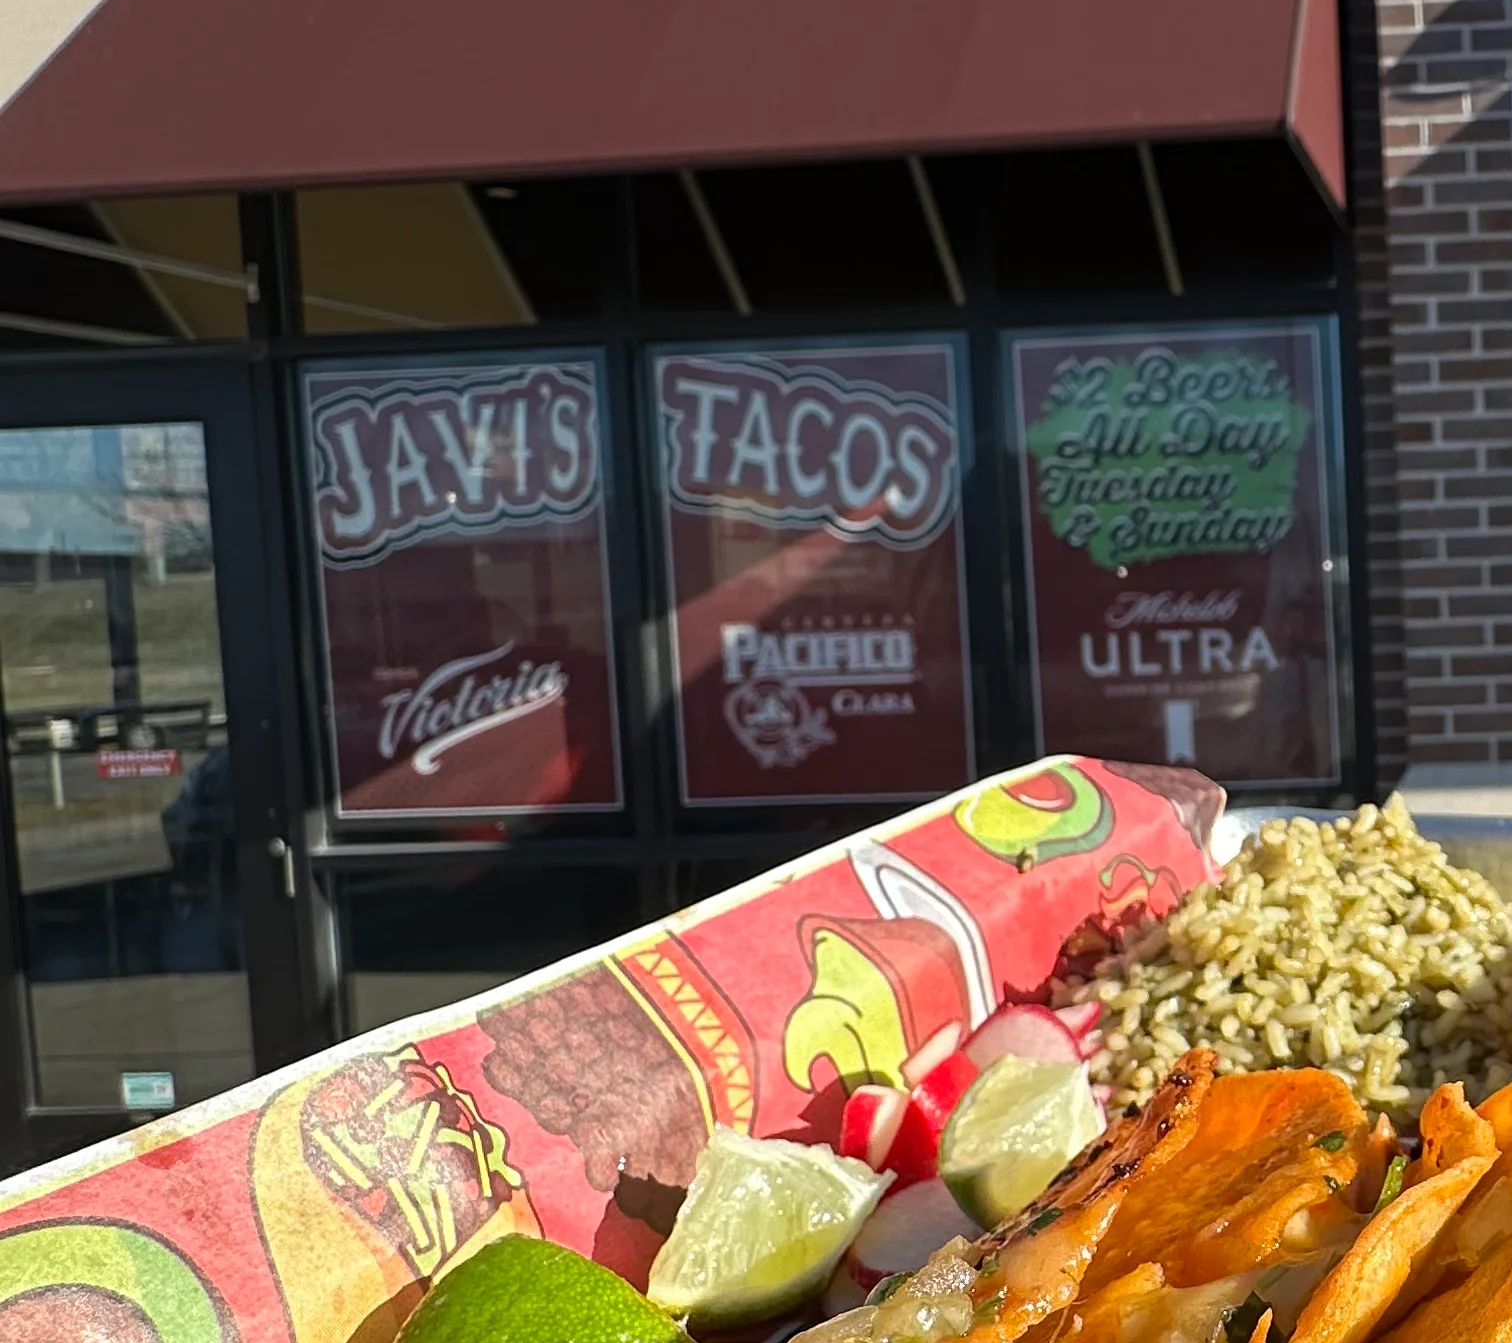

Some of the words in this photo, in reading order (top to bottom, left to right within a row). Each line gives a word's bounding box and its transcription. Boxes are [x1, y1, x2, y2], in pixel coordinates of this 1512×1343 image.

[1123, 347, 1290, 404] Beers
[332, 383, 578, 538] JAVI'S
[676, 377, 938, 518] TACOS
[1055, 405, 1151, 462] All
[1160, 399, 1290, 469] Day
[1039, 457, 1238, 513] Tuesday
[1109, 499, 1292, 558] Sunday
[1080, 625, 1280, 678] ULTRA
[379, 640, 568, 774] Victoria
